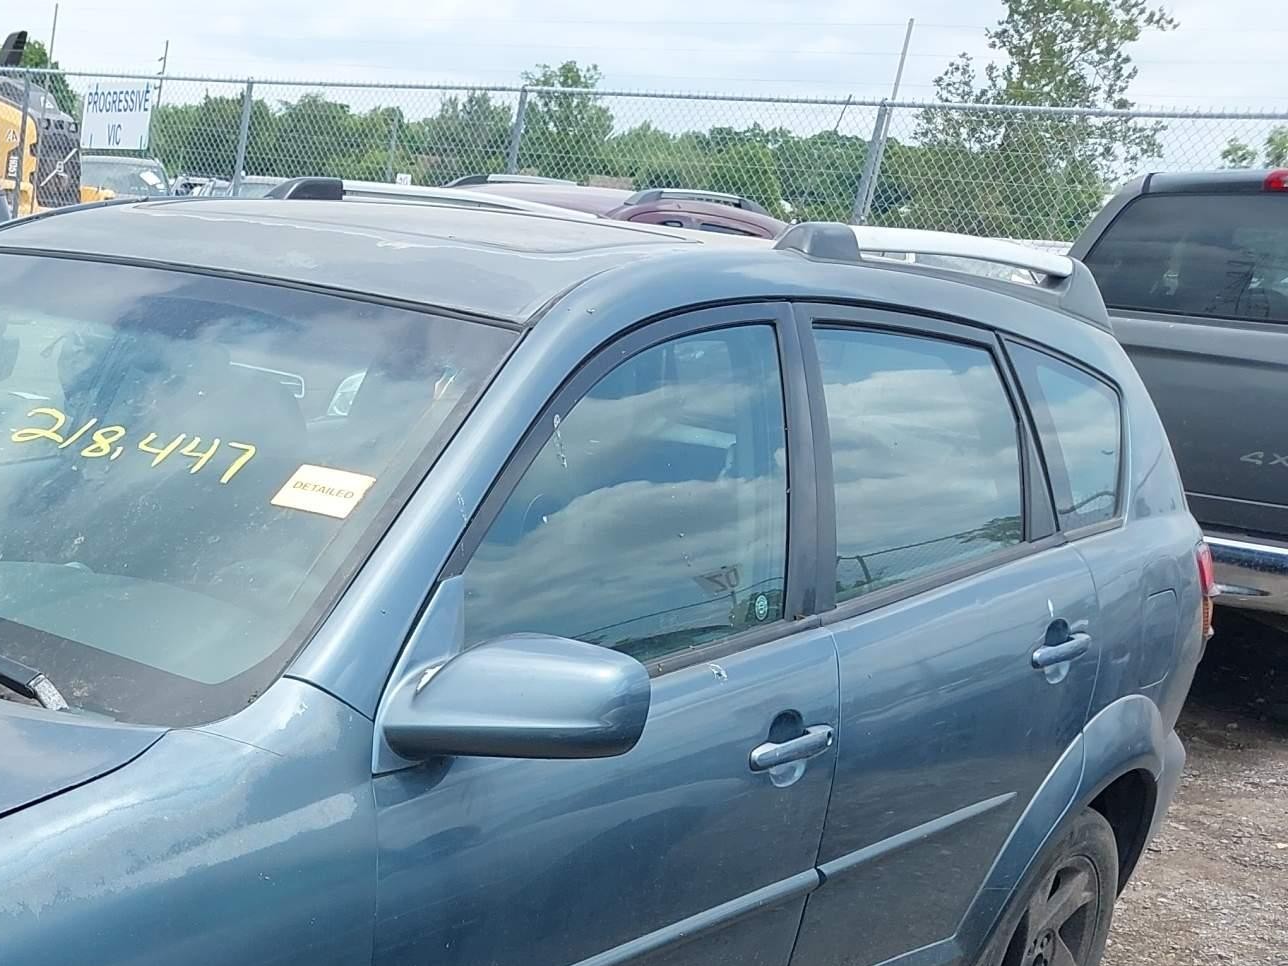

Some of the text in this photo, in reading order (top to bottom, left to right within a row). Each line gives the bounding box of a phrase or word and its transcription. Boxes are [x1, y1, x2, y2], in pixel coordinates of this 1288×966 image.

[87, 90, 151, 113] PROGRESSIVE
[107, 124, 122, 146] VIC
[11, 407, 257, 485] 218,447
[292, 480, 355, 499] DETAILED
